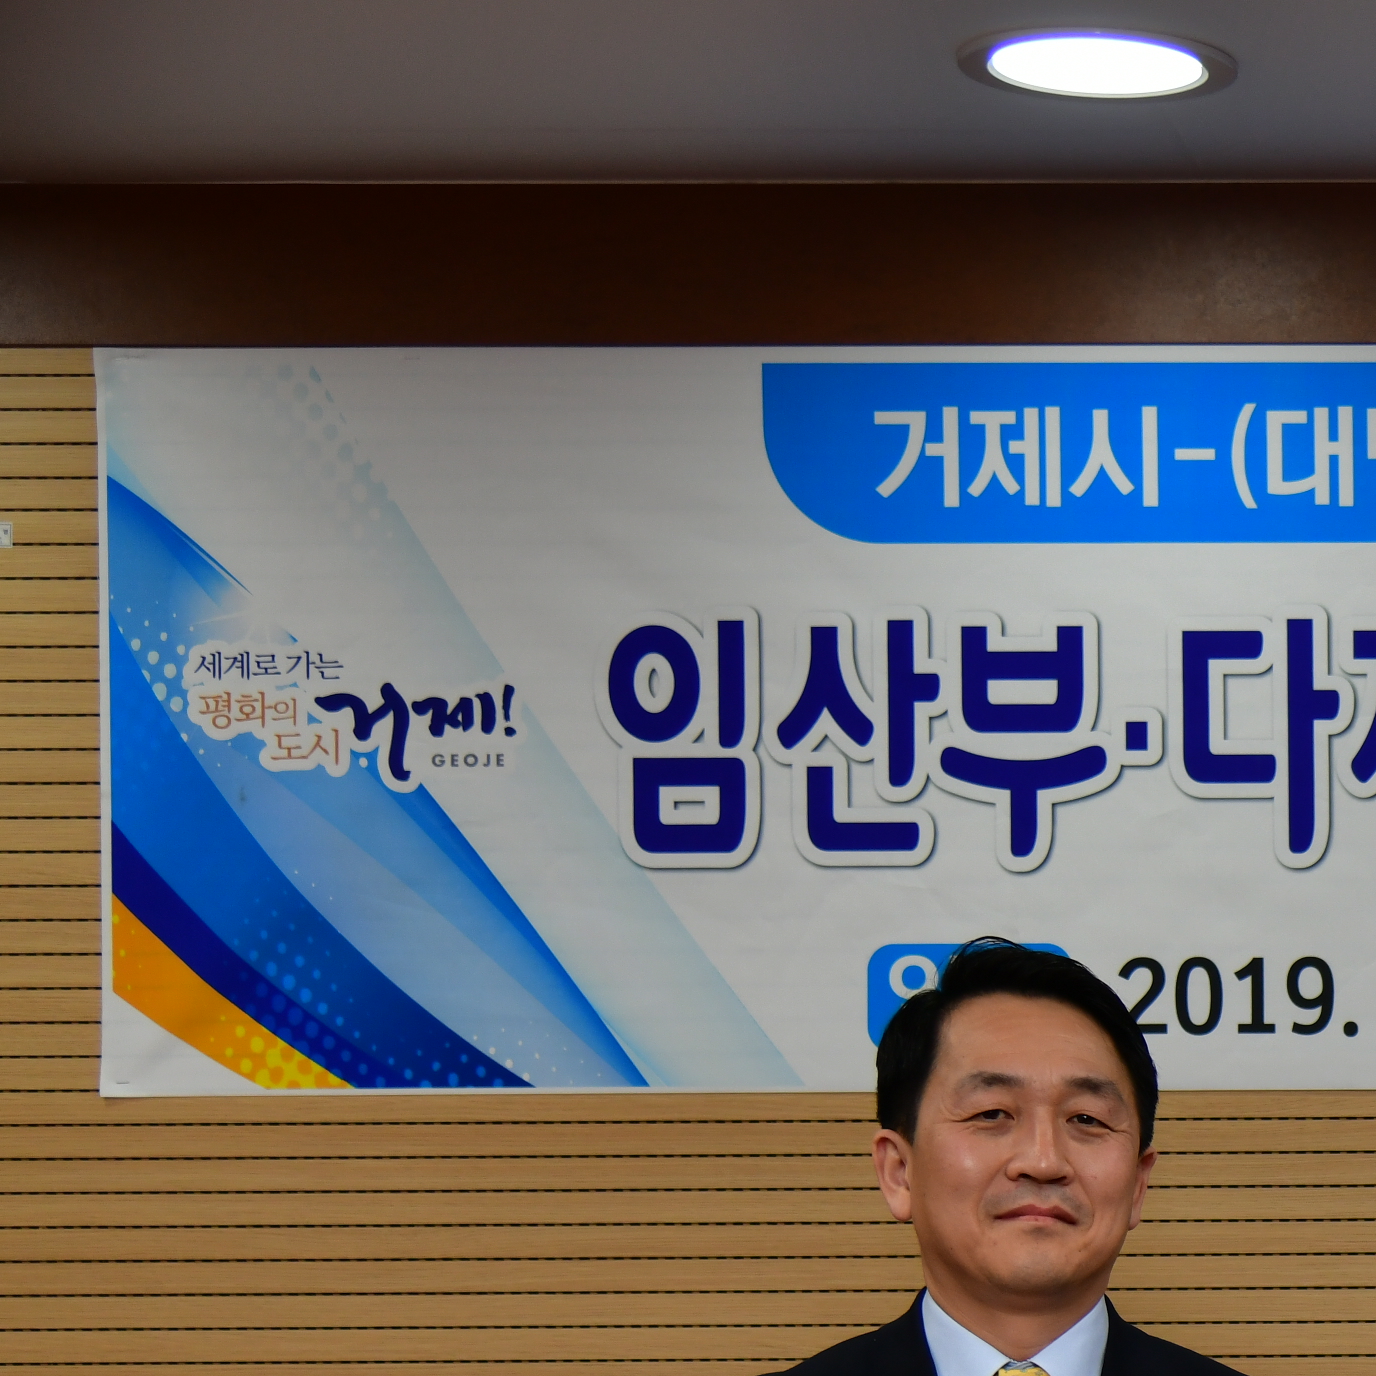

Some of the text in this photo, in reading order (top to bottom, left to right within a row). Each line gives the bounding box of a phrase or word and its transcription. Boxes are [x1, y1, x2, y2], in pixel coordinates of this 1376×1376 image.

[194, 650, 344, 681] 세계로 가는
[198, 690, 298, 730] 평화의
[271, 727, 341, 767] 도시
[314, 682, 517, 782] 거제!
[431, 753, 506, 768] GEOJE
[1117, 956, 1358, 1037] 2019.
